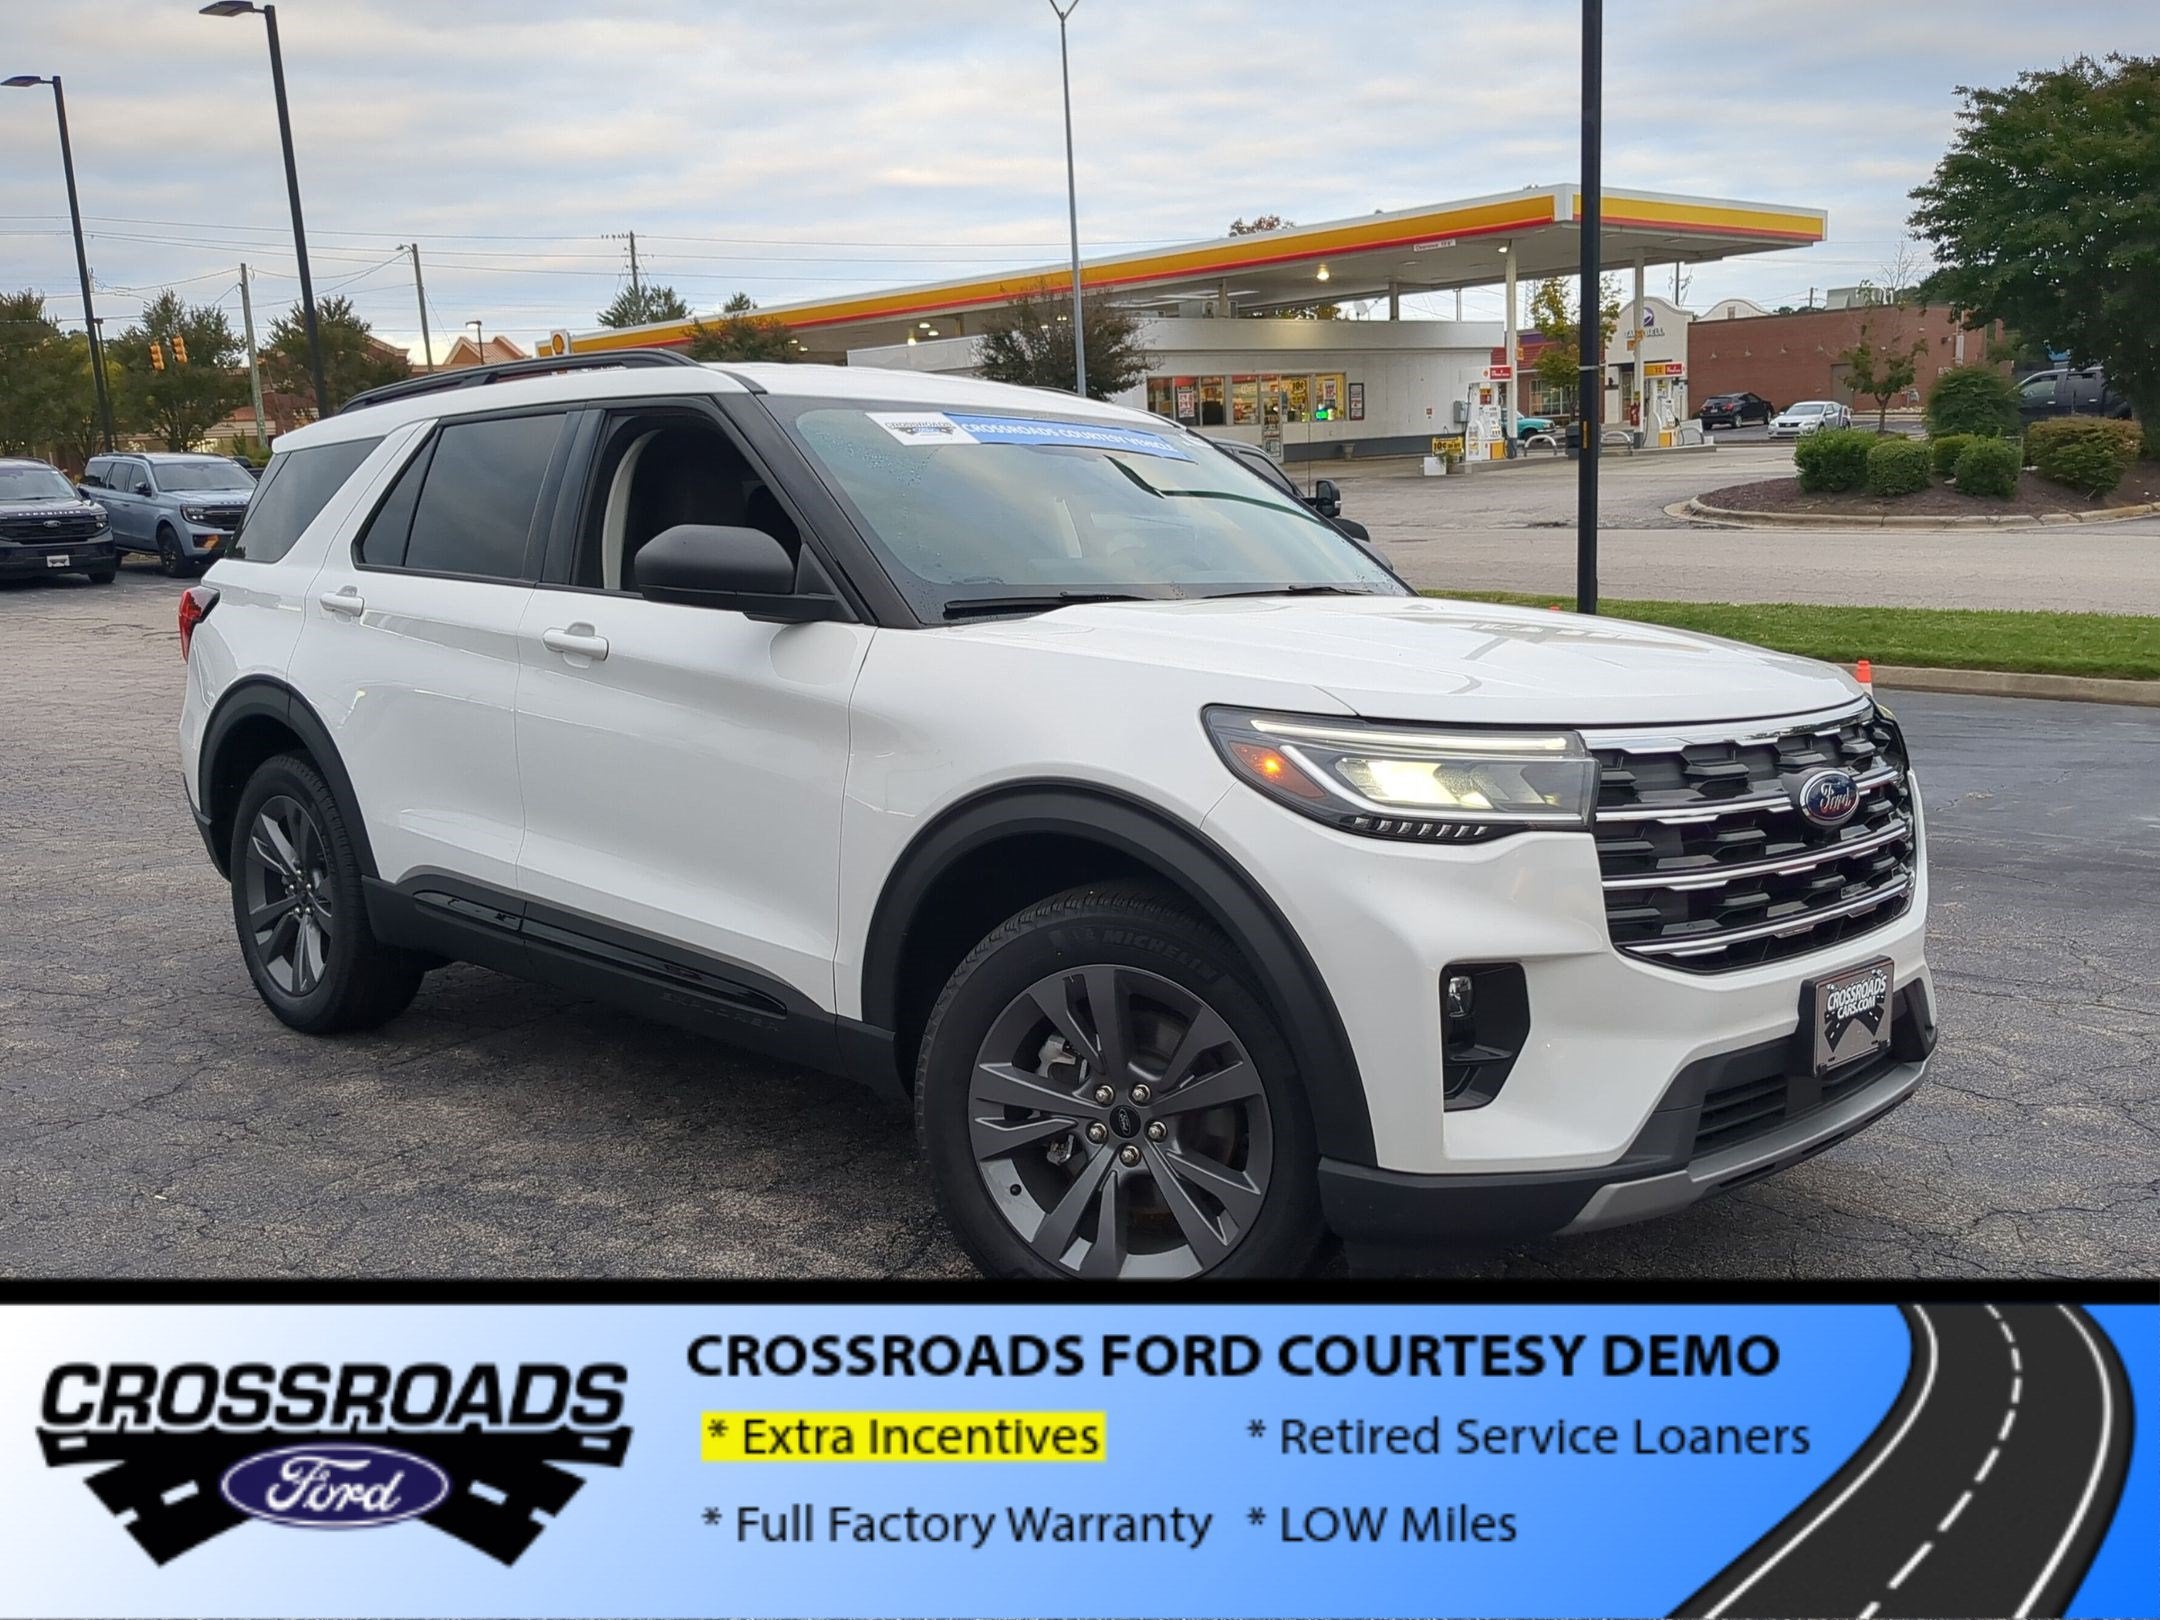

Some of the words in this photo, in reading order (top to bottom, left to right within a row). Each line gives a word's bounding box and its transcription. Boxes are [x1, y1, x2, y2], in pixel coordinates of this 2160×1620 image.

[961, 422, 1056, 438] CROSSROADS
[1058, 428, 1126, 445] COURTESY
[1820, 782, 1852, 813] Ford
[1101, 929, 1218, 982] MICHELIN
[1827, 975, 1888, 1012] CROSSROADS
[1837, 996, 1877, 1020] CARS.COM
